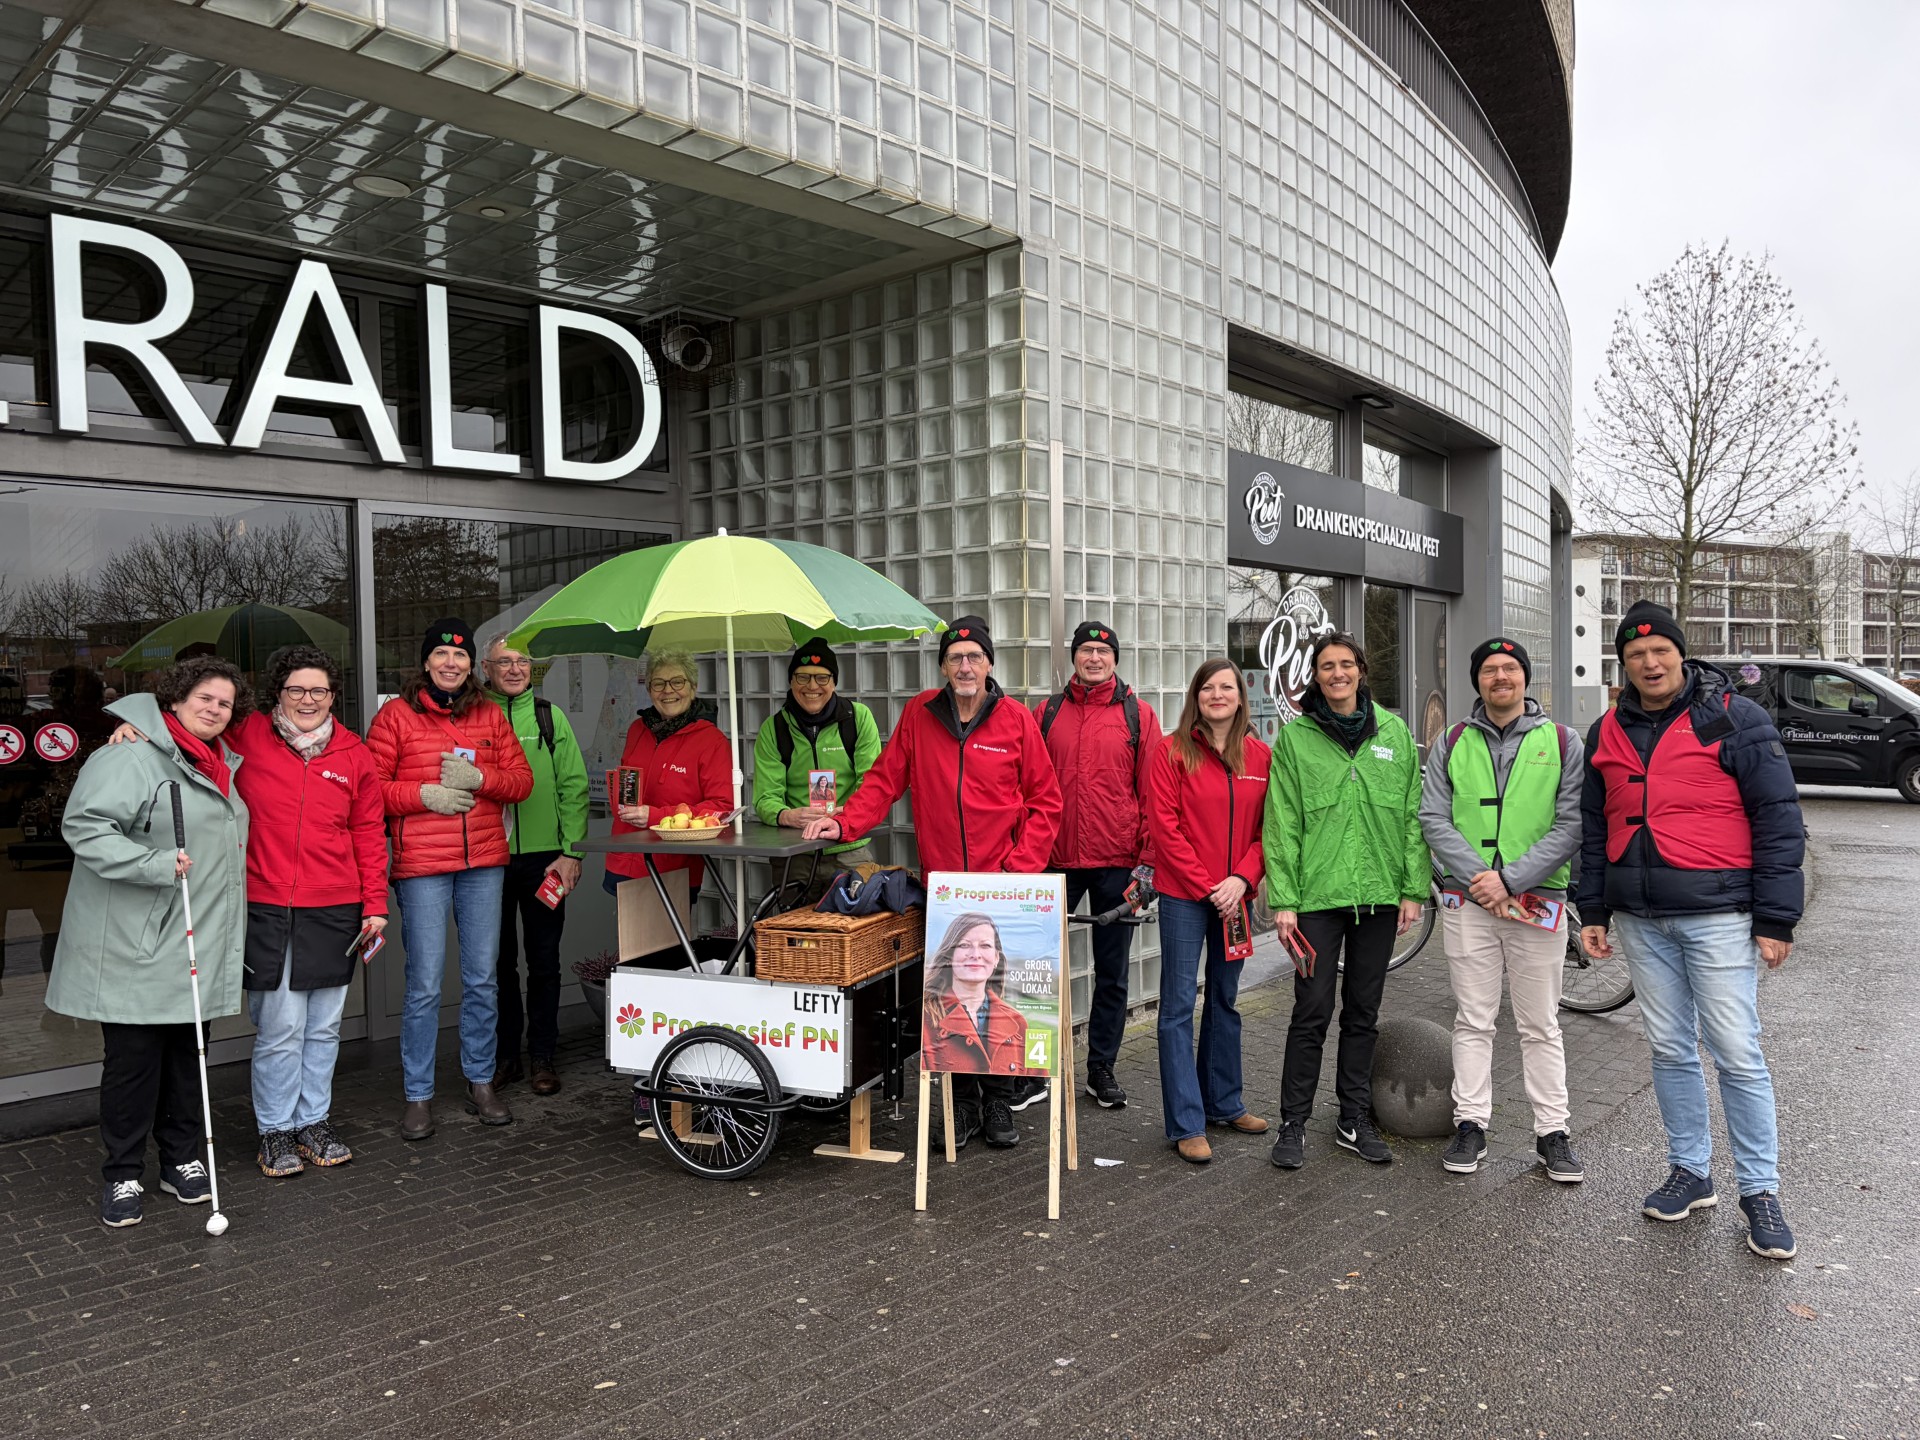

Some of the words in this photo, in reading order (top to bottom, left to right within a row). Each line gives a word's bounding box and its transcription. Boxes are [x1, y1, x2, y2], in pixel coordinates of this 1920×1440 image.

[0, 213, 661, 481] RALD
[1246, 485, 1285, 524] Peet
[1296, 504, 1421, 553] DRANKENSPECIAALZAAK
[1422, 536, 1440, 558] PEET
[1283, 591, 1321, 614] DRANKEN
[331, 772, 348, 784] PvdA
[670, 764, 686, 774] PvdA
[955, 888, 1032, 902] Progressief
[1035, 889, 1055, 901] PN
[1036, 904, 1051, 913] PvdA
[1025, 960, 1053, 972] GROEN,
[1010, 971, 1043, 982] SOCIAAL
[1046, 974, 1052, 982] &
[1022, 983, 1052, 994] LOKAAL
[794, 991, 841, 1014] LEFTY
[802, 1026, 839, 1053] PN
[1028, 1040, 1048, 1065] 4
